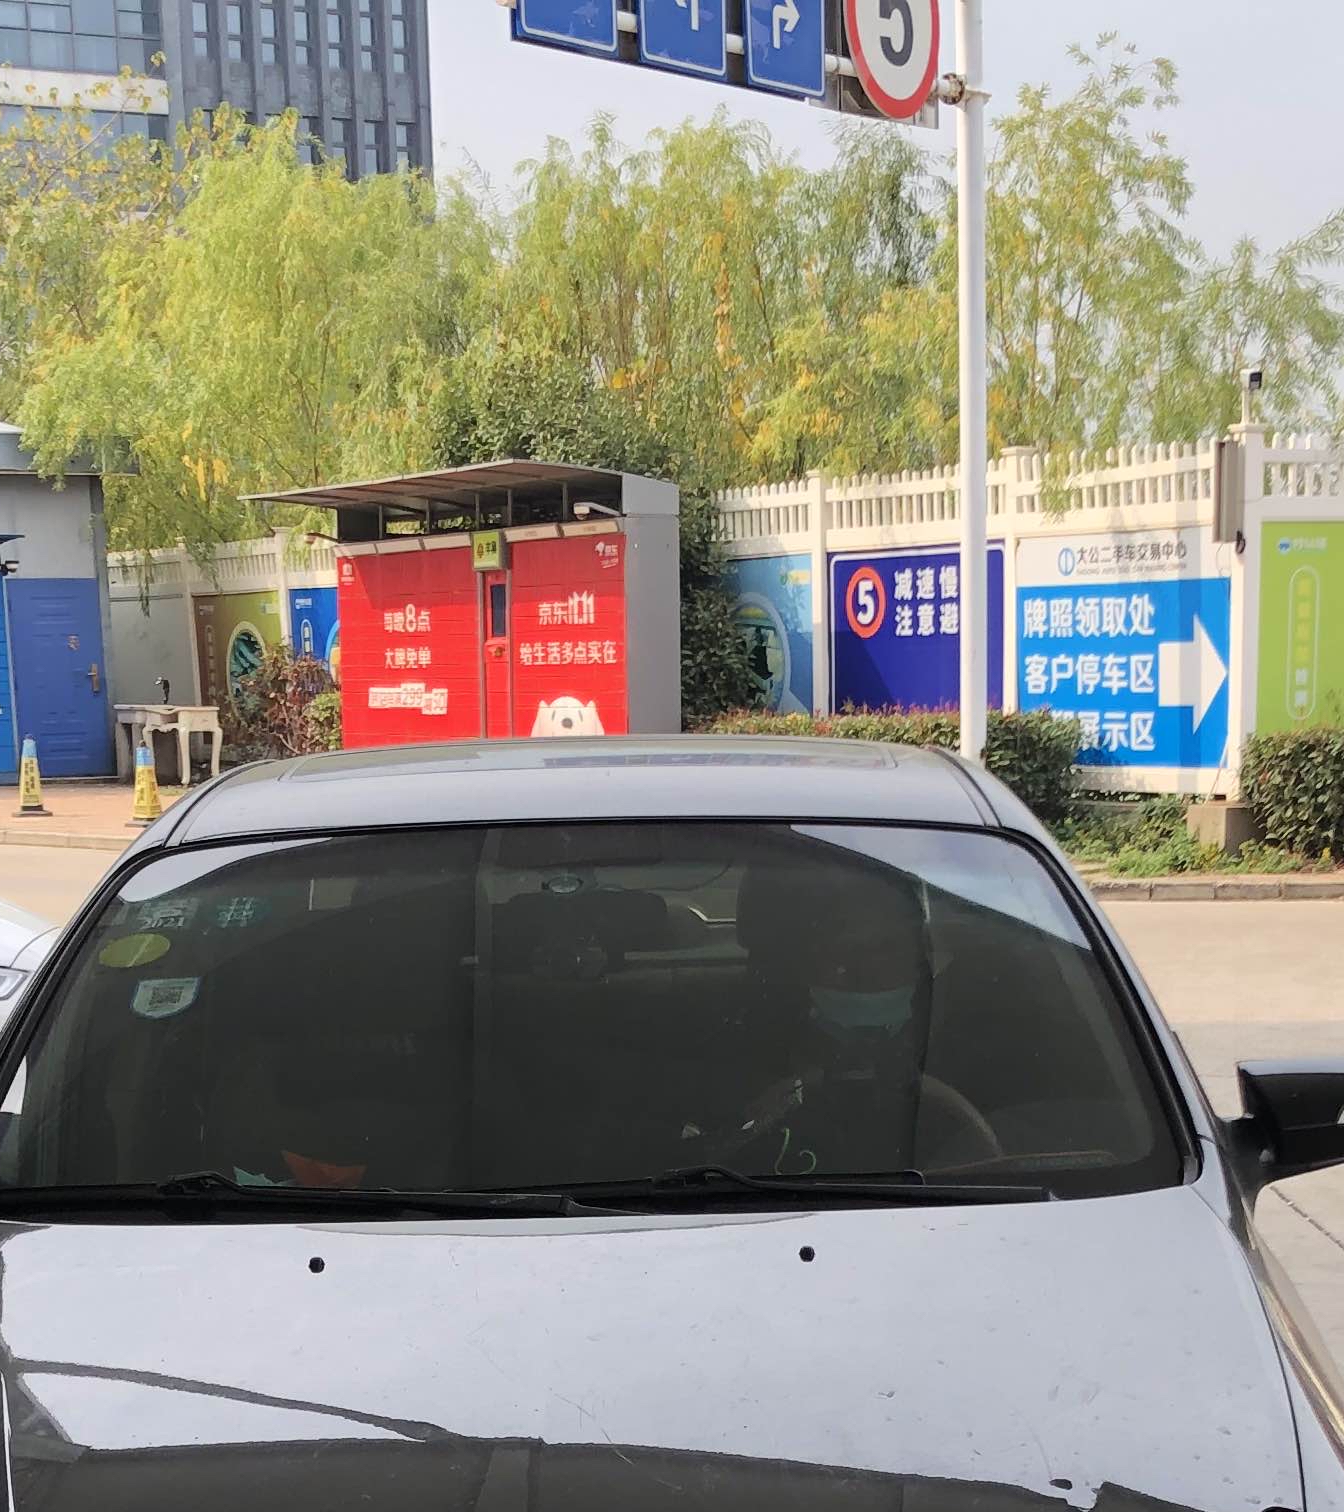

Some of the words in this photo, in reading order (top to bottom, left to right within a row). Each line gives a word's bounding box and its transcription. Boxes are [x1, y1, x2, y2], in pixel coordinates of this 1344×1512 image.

[878, 0, 914, 66] 5
[1076, 541, 1187, 565] 大公二手车交易中心
[857, 579, 875, 625] 5
[1023, 594, 1155, 639] 牌照领取处
[520, 639, 617, 666] 给生活多点实在
[1024, 653, 1155, 695] 客户停车区
[1052, 711, 1155, 752] 展示区
